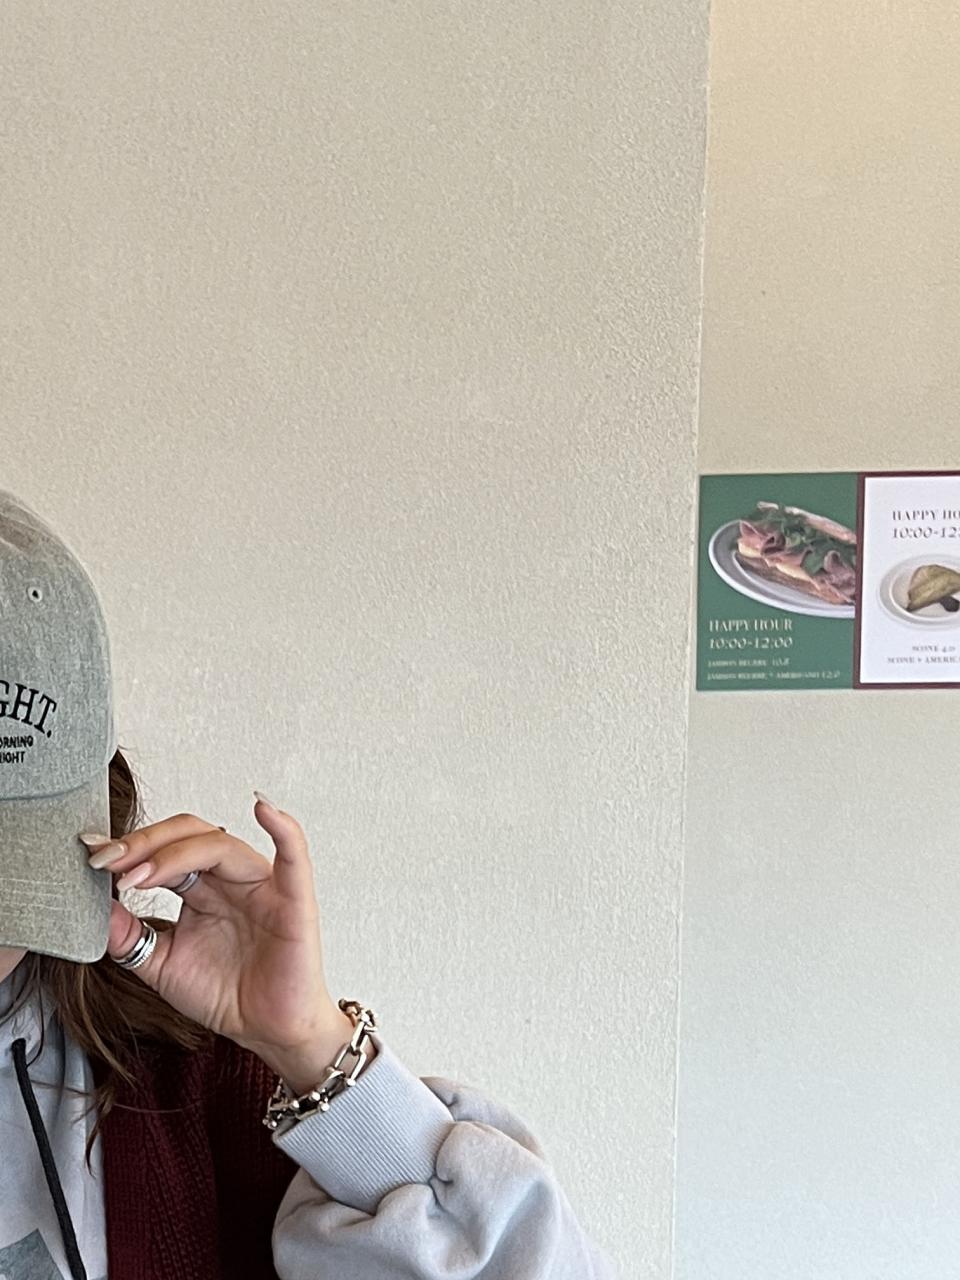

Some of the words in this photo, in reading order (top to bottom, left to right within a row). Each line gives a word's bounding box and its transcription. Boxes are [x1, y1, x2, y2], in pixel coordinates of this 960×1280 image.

[892, 509, 938, 521] HAPPY
[709, 620, 749, 632] HAPPY
[754, 619, 793, 631] HOUR
[709, 637, 793, 649] 10:00-12:00
